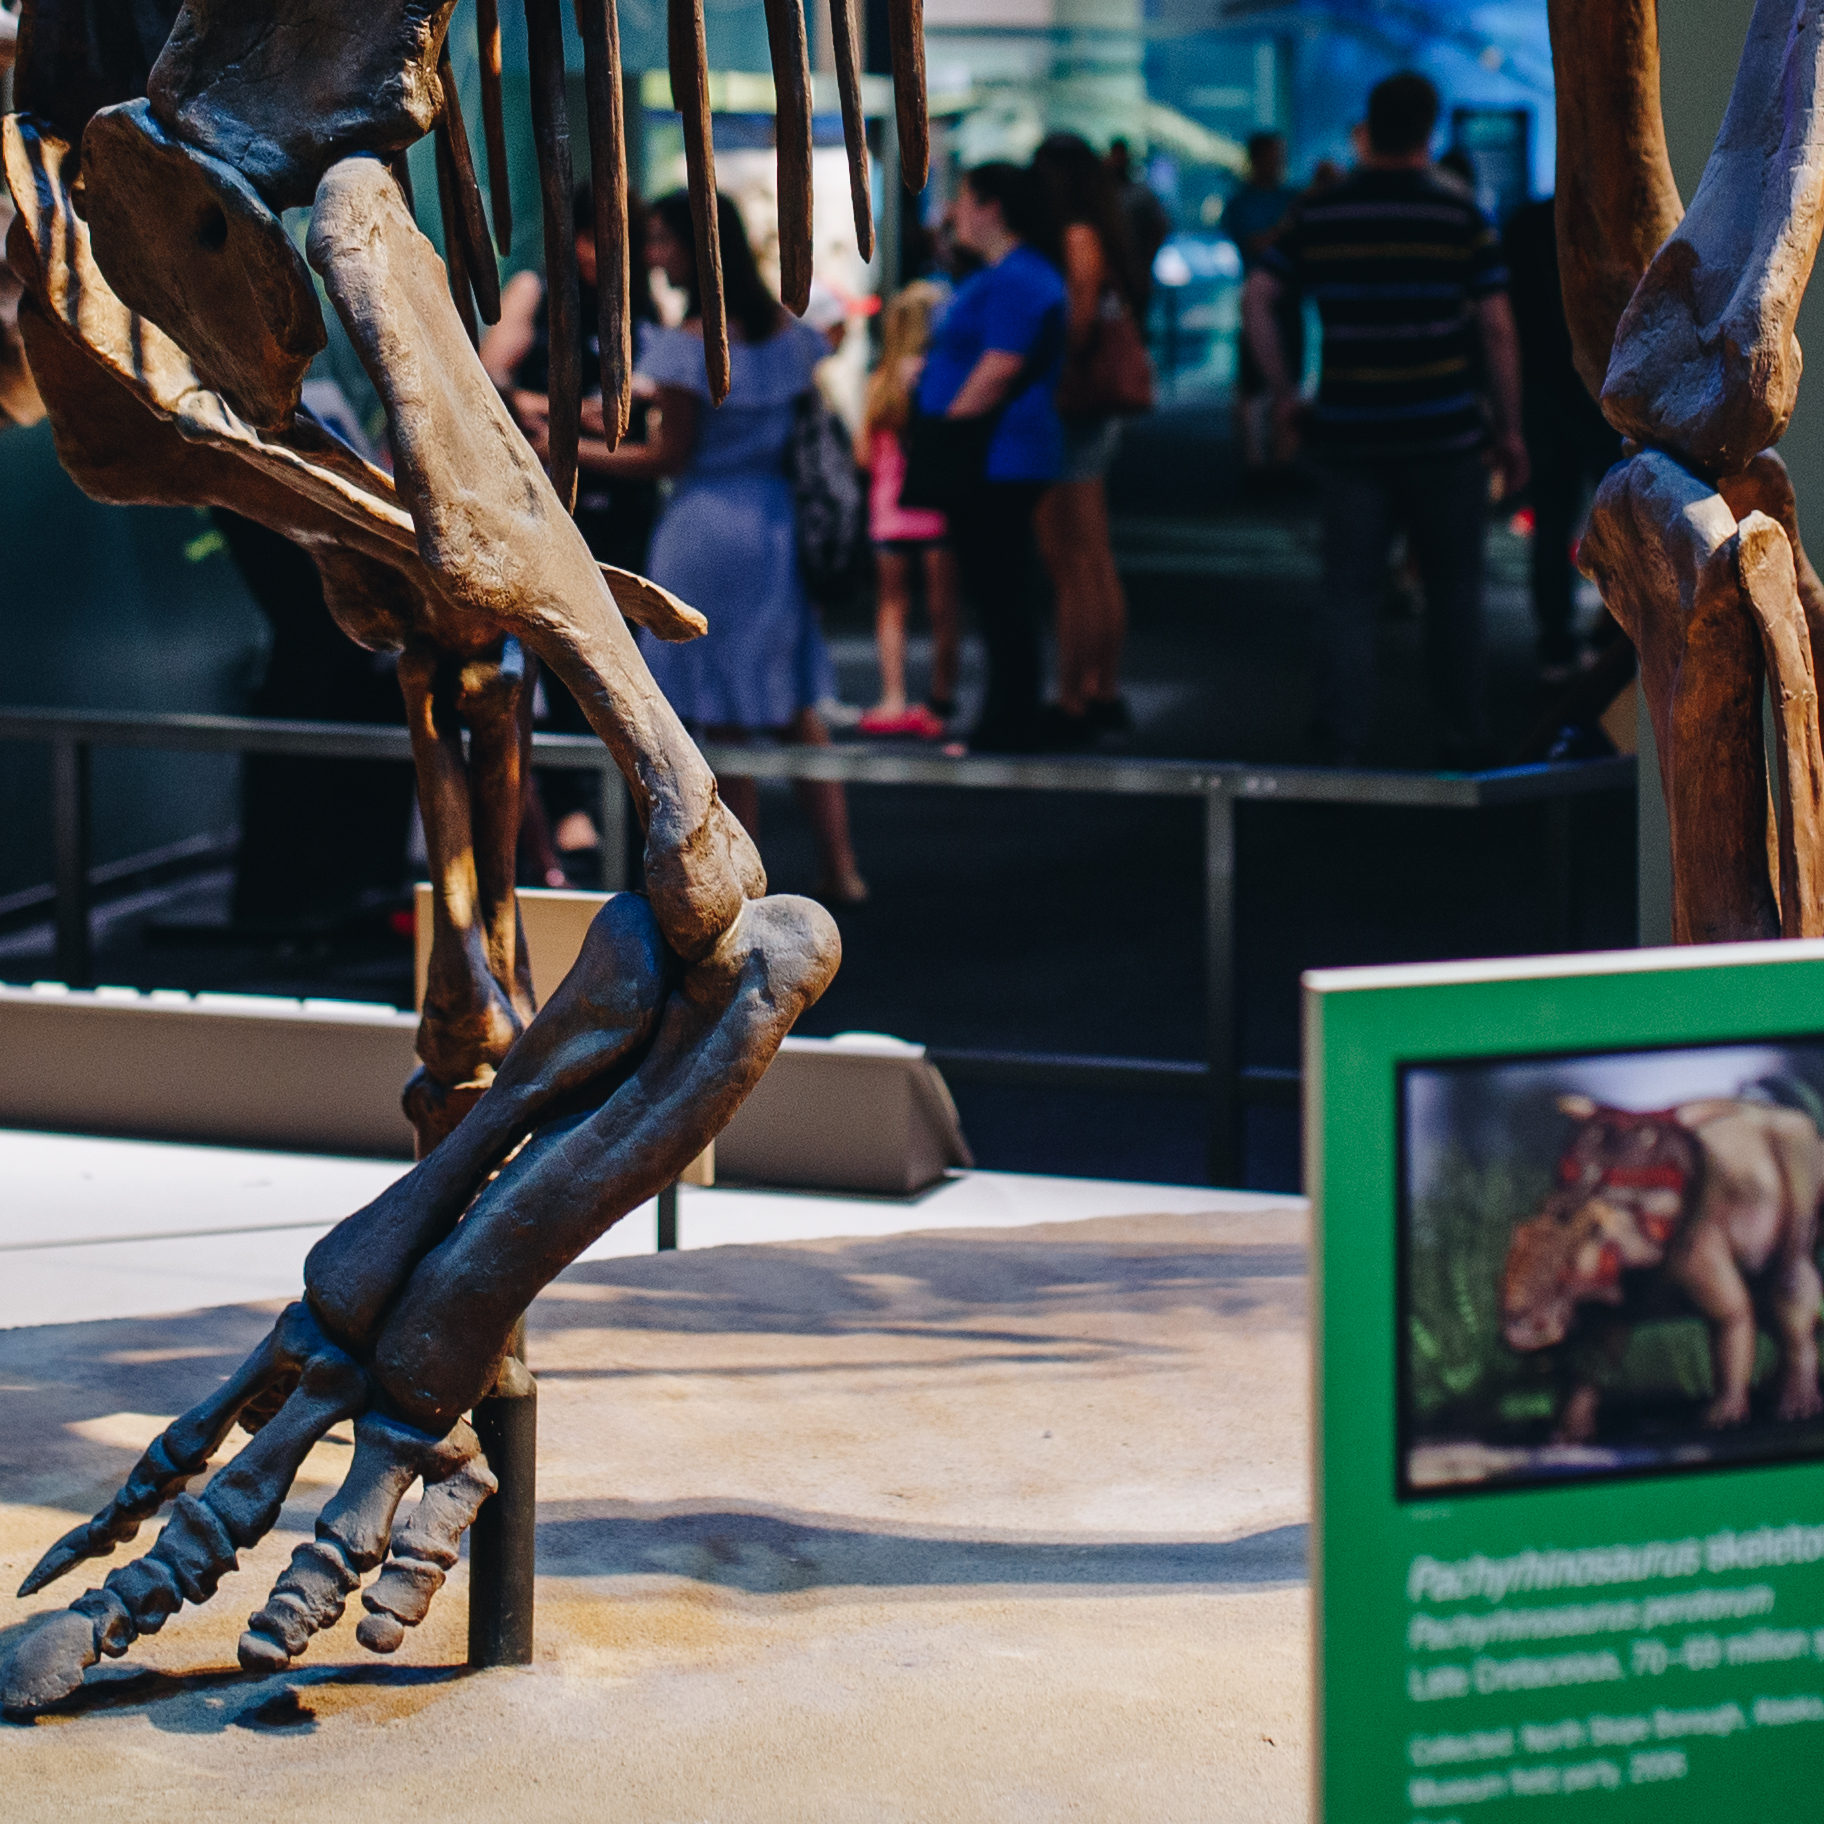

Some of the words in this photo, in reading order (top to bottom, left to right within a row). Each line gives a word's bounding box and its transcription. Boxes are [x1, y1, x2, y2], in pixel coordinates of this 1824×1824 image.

[1408, 1537, 1701, 1603] Pachyrhinosaurus
[1408, 1603, 1639, 1651] Pachyrhinosaurus
[1408, 1664, 1468, 1701] Late
[1726, 1626, 1810, 1665] million
